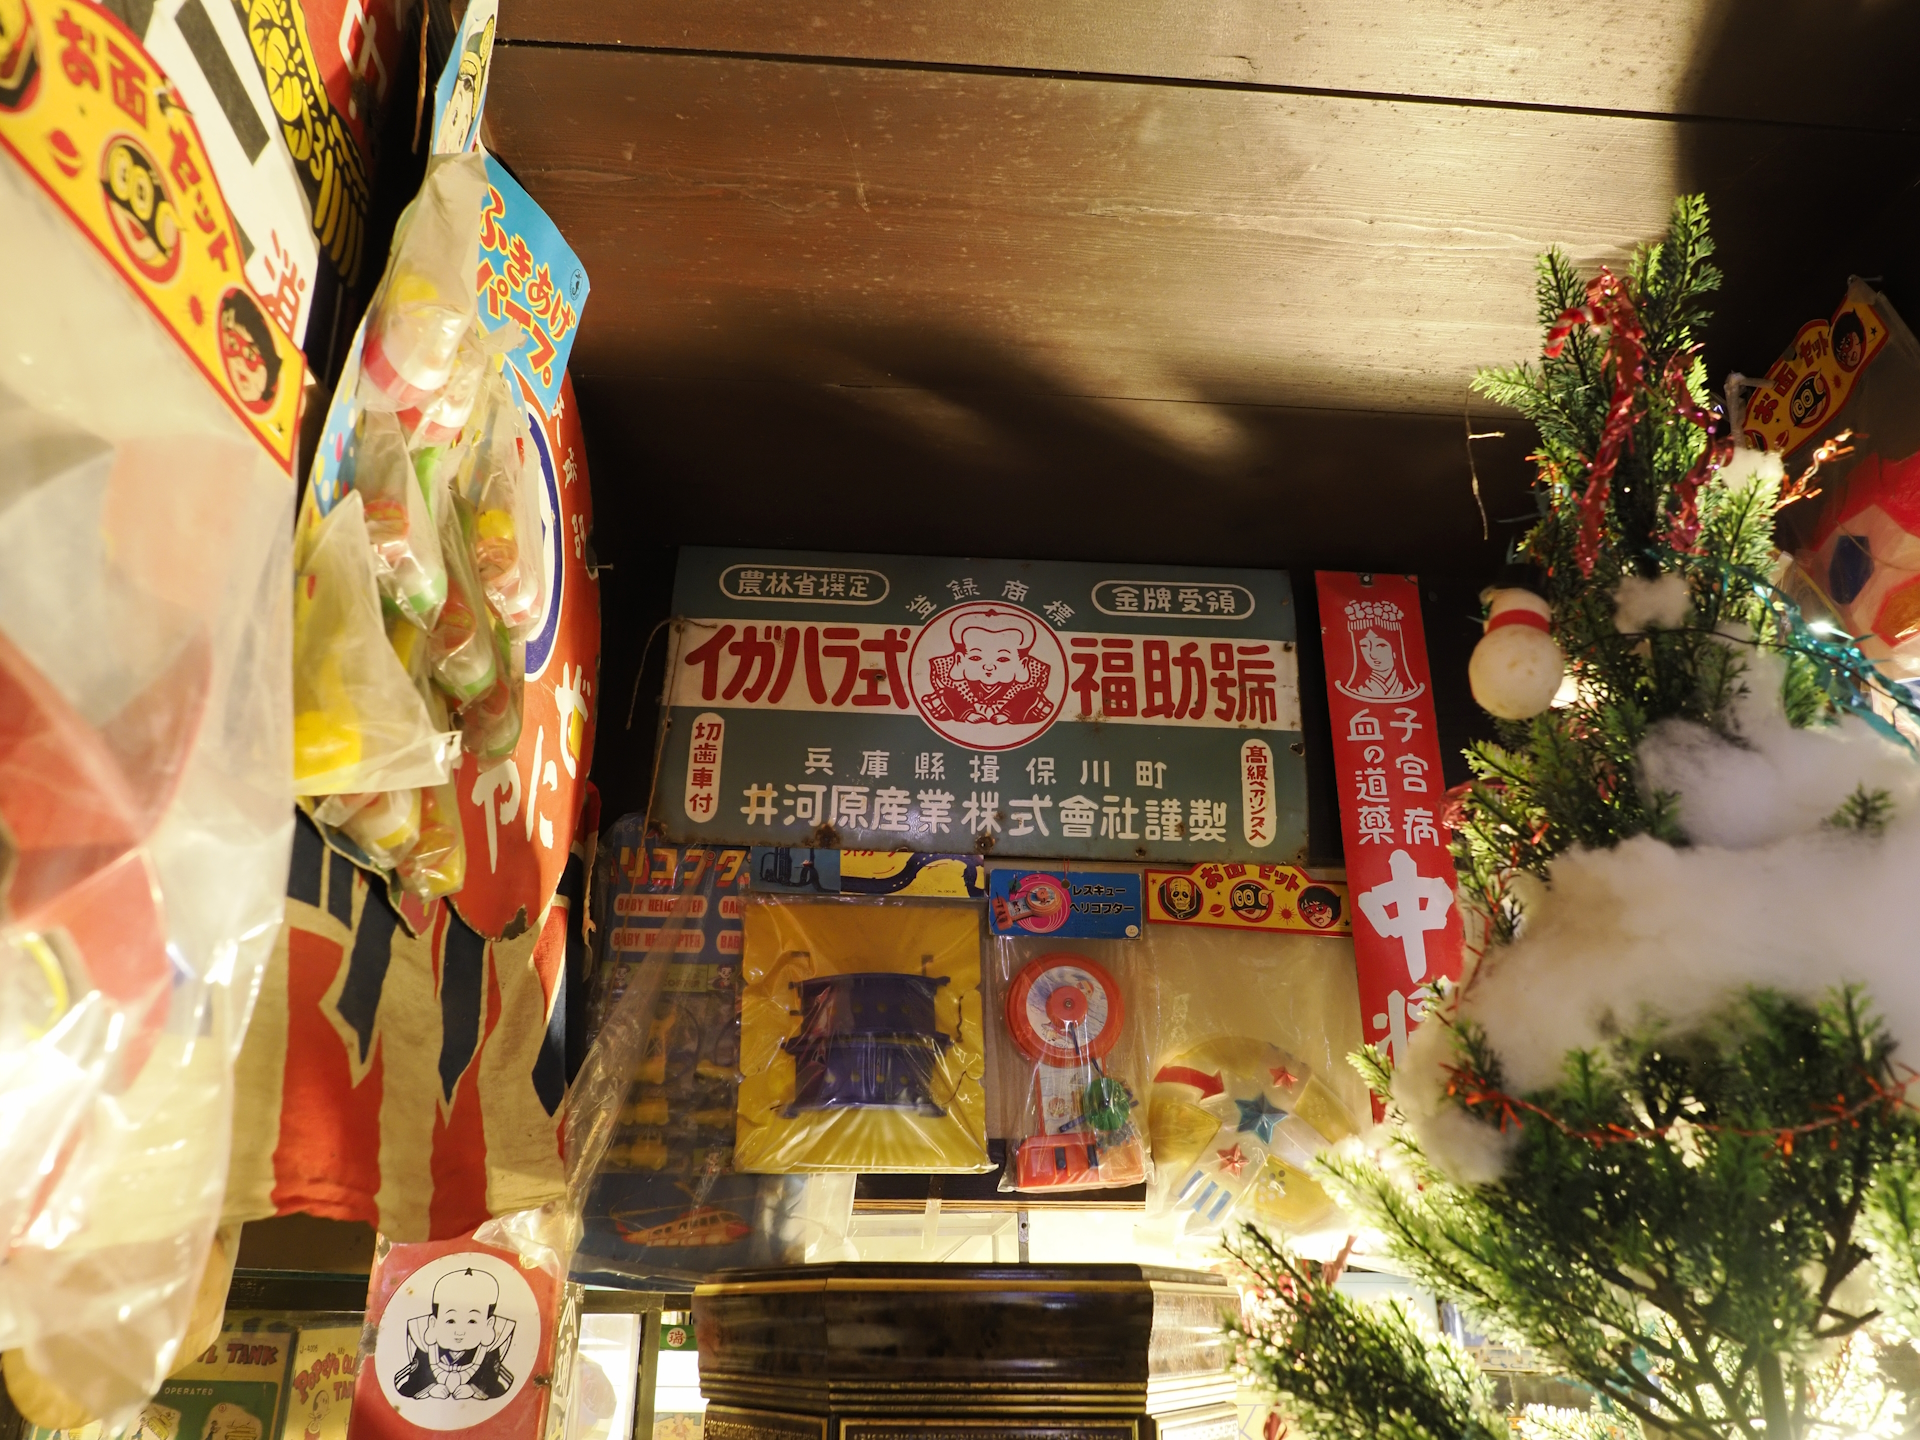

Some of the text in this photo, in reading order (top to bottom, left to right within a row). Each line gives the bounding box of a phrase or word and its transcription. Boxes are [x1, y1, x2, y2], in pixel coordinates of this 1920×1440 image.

[1753, 331, 1829, 425] お面セット
[738, 570, 870, 598] 農林省撰定
[905, 577, 1076, 627] 登録商標
[1111, 586, 1236, 614] 金牌受領
[684, 624, 912, 709] イガハラ式
[1389, 707, 1440, 847] 子宮病
[1073, 885, 1126, 897] レスキュー
[648, 899, 704, 913] HELICER
[644, 933, 702, 948] HEPTER
[226, 1343, 279, 1366] TANK
[164, 1387, 213, 1396] OPERATED
